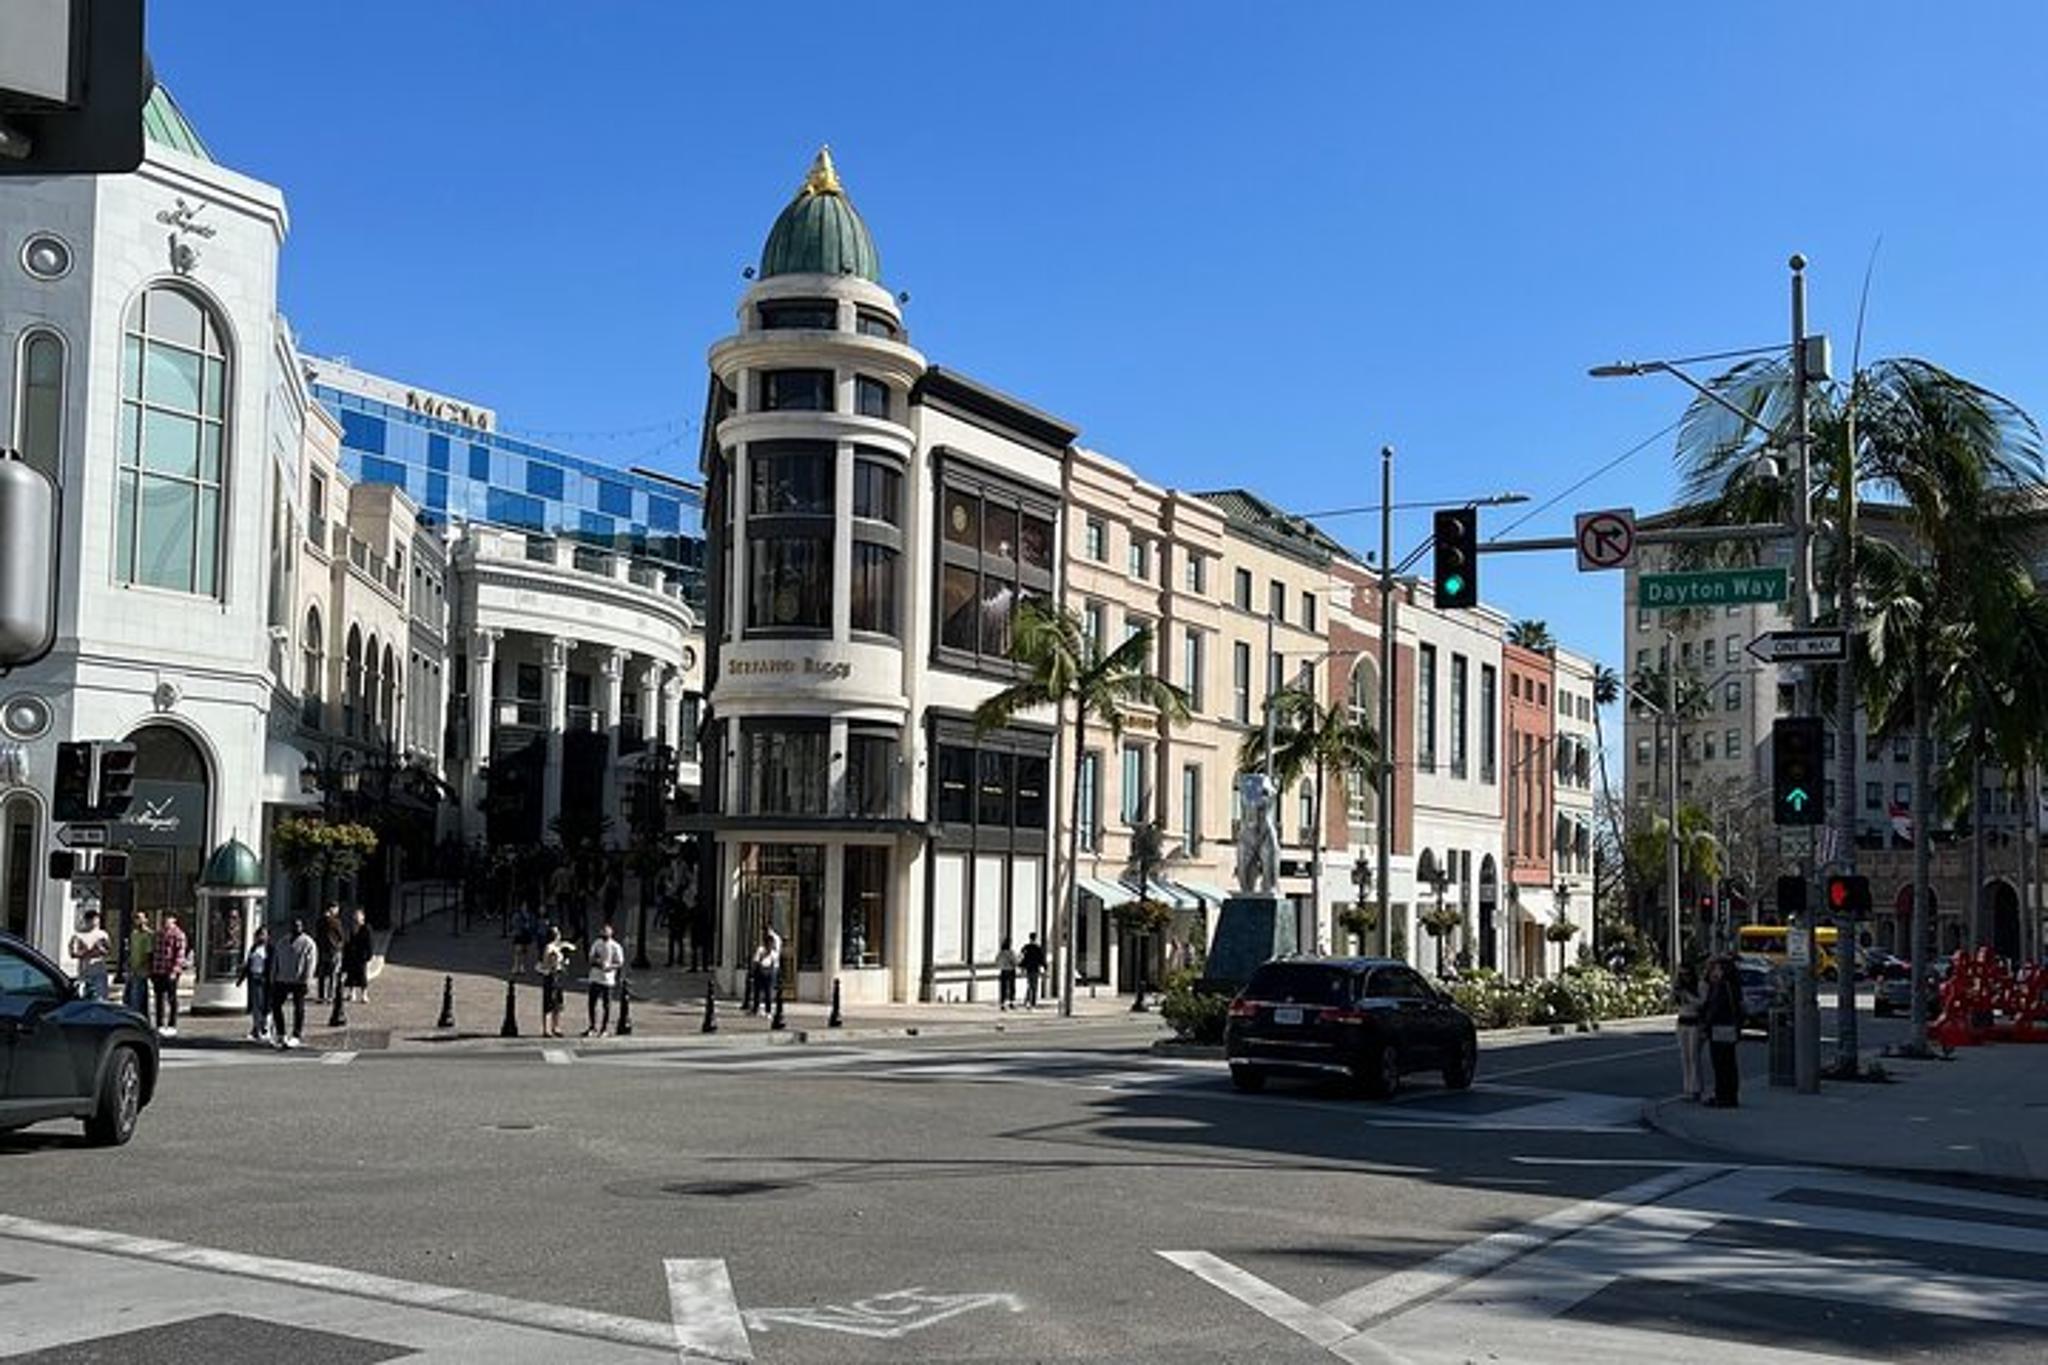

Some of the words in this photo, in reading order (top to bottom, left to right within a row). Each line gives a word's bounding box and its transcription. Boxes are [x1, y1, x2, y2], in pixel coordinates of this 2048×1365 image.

[1649, 582, 1725, 603] Dayton
[1732, 577, 1777, 598] Way
[1774, 641, 1799, 653] ONE
[1807, 639, 1838, 652] WAY
